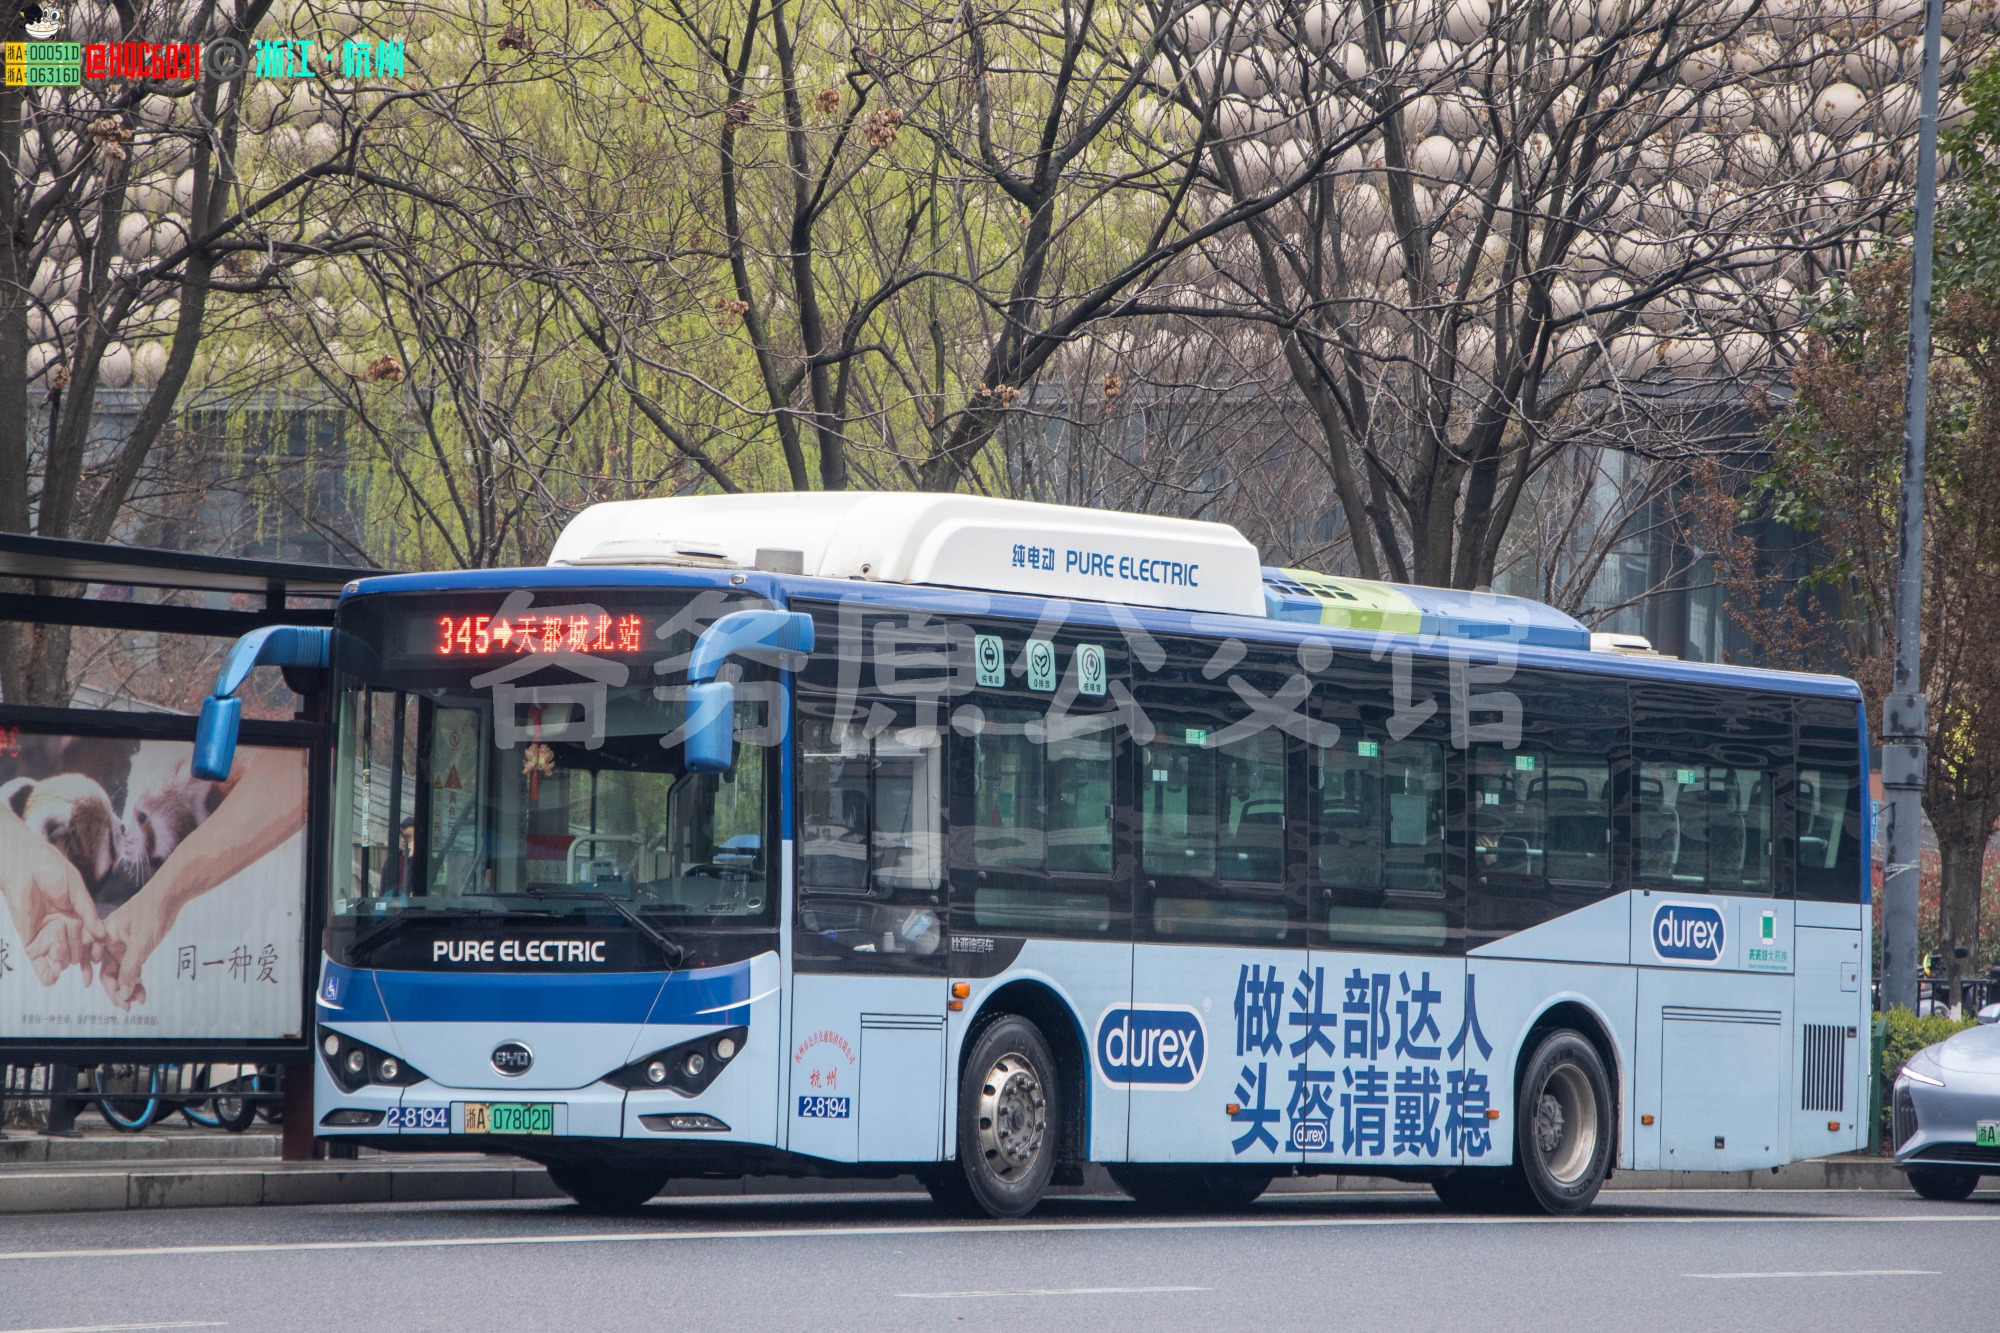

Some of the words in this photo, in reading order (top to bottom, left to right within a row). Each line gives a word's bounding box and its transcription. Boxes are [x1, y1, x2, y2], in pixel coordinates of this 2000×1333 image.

[1012, 543, 1055, 571] 纯电动
[1066, 550, 1114, 578] PURE
[1119, 556, 1199, 587] ELECTRIC
[439, 616, 490, 654] 345
[515, 614, 641, 653] 天都城北站
[981, 675, 1000, 684] 纯电动
[1658, 910, 1719, 953] durex
[176, 943, 279, 984] 同一种爱
[433, 940, 494, 962] PURE
[499, 940, 606, 962] ELECTRIC
[1233, 963, 1493, 1062] 做头部达人
[495, 1051, 528, 1067] BYD
[1106, 1022, 1198, 1076] durex
[388, 1107, 447, 1128] 2-8194
[803, 1097, 847, 1118] 2-8194
[1231, 1063, 1492, 1159] 头盔请戴稳
